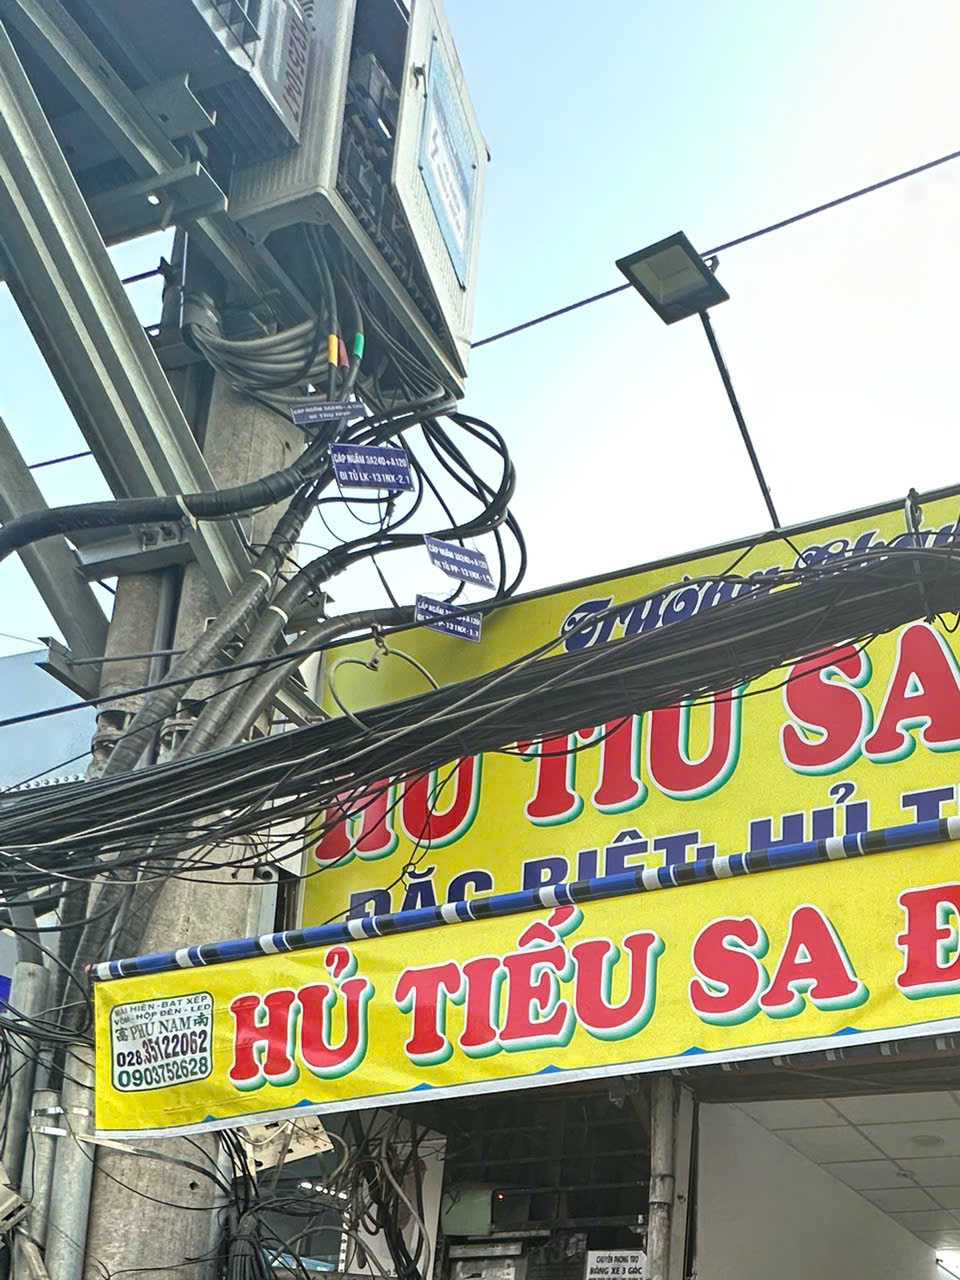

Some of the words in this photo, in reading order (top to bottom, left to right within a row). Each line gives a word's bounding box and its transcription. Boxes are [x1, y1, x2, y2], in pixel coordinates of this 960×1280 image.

[191, 1004, 211, 1012] LED
[229, 944, 375, 1092] HỦ
[395, 904, 666, 1067] TIẾU
[689, 904, 870, 1027] SA
[159, 1016, 192, 1035] NAM
[118, 1056, 208, 1088] 0903752628
